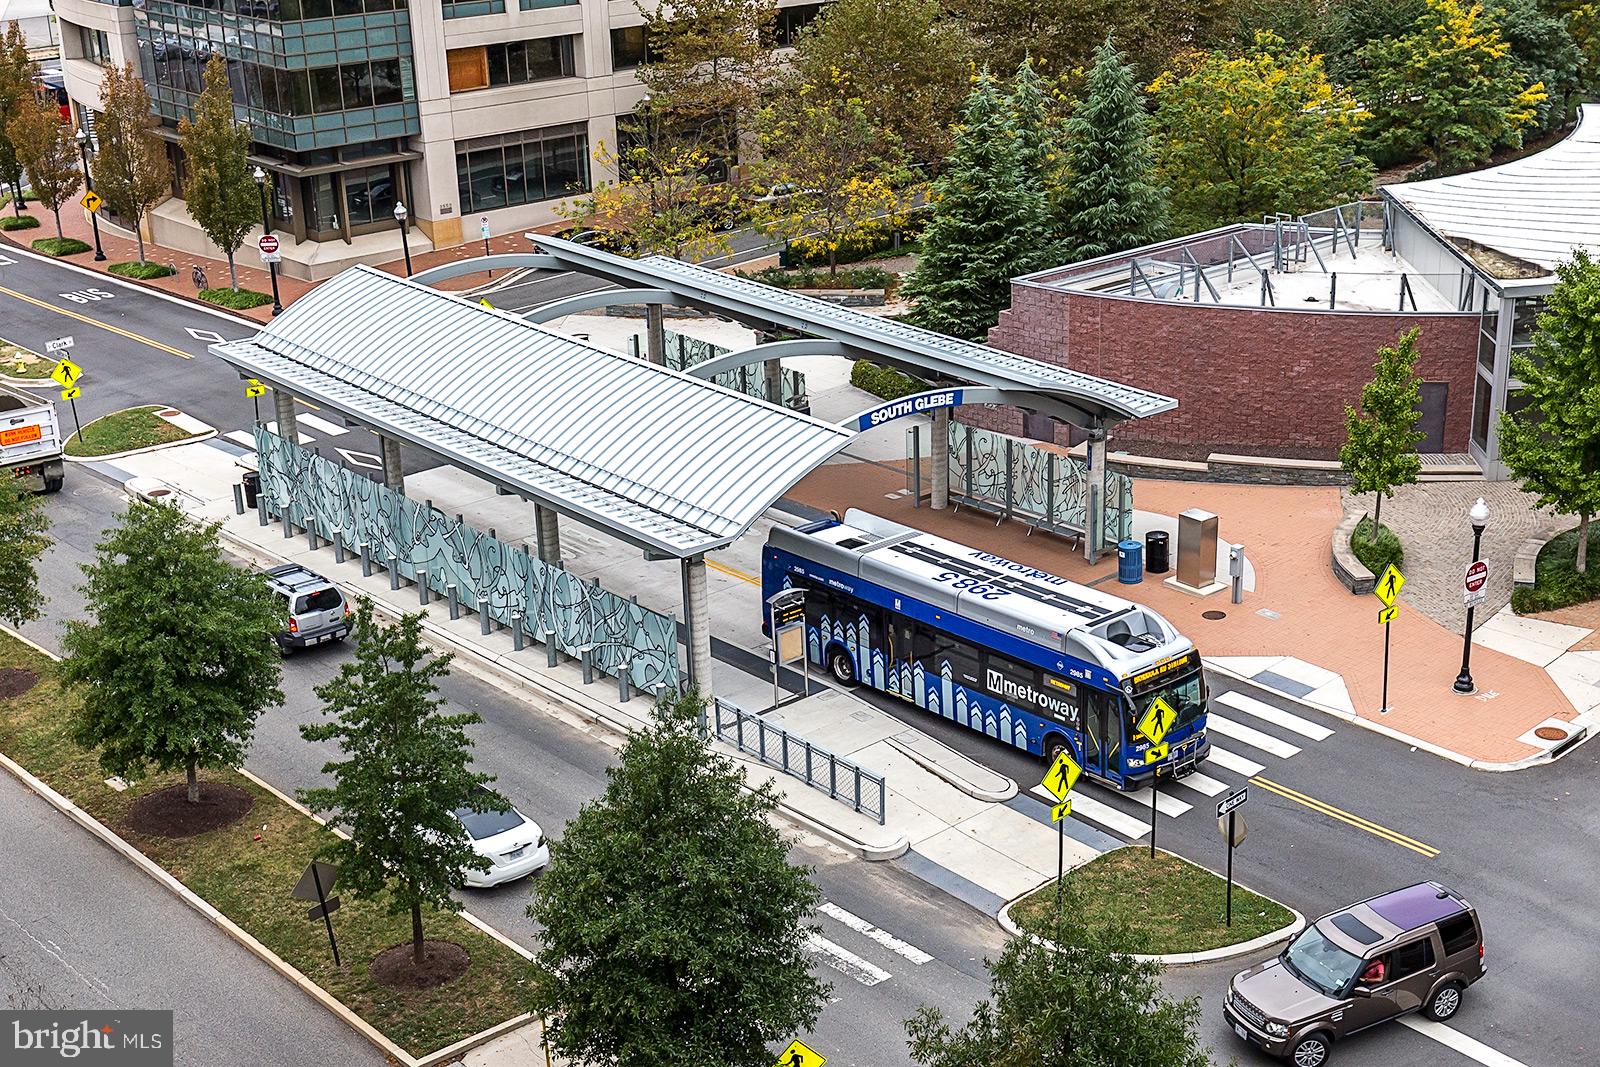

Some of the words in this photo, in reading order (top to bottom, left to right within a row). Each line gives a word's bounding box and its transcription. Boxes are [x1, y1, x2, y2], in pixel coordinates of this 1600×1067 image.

[58, 288, 115, 304] BUS
[52, 341, 67, 349] Clark
[870, 400, 912, 425] SOUTH
[914, 392, 954, 411] GLEBE
[968, 551, 1068, 586] metroway
[1468, 568, 1476, 576] DO
[1477, 565, 1486, 573] NOT
[828, 579, 854, 594] metroway
[931, 572, 1012, 600] 2985
[1468, 579, 1483, 589] ENTER
[1016, 624, 1035, 636] metro
[1003, 679, 1079, 722] metroway
